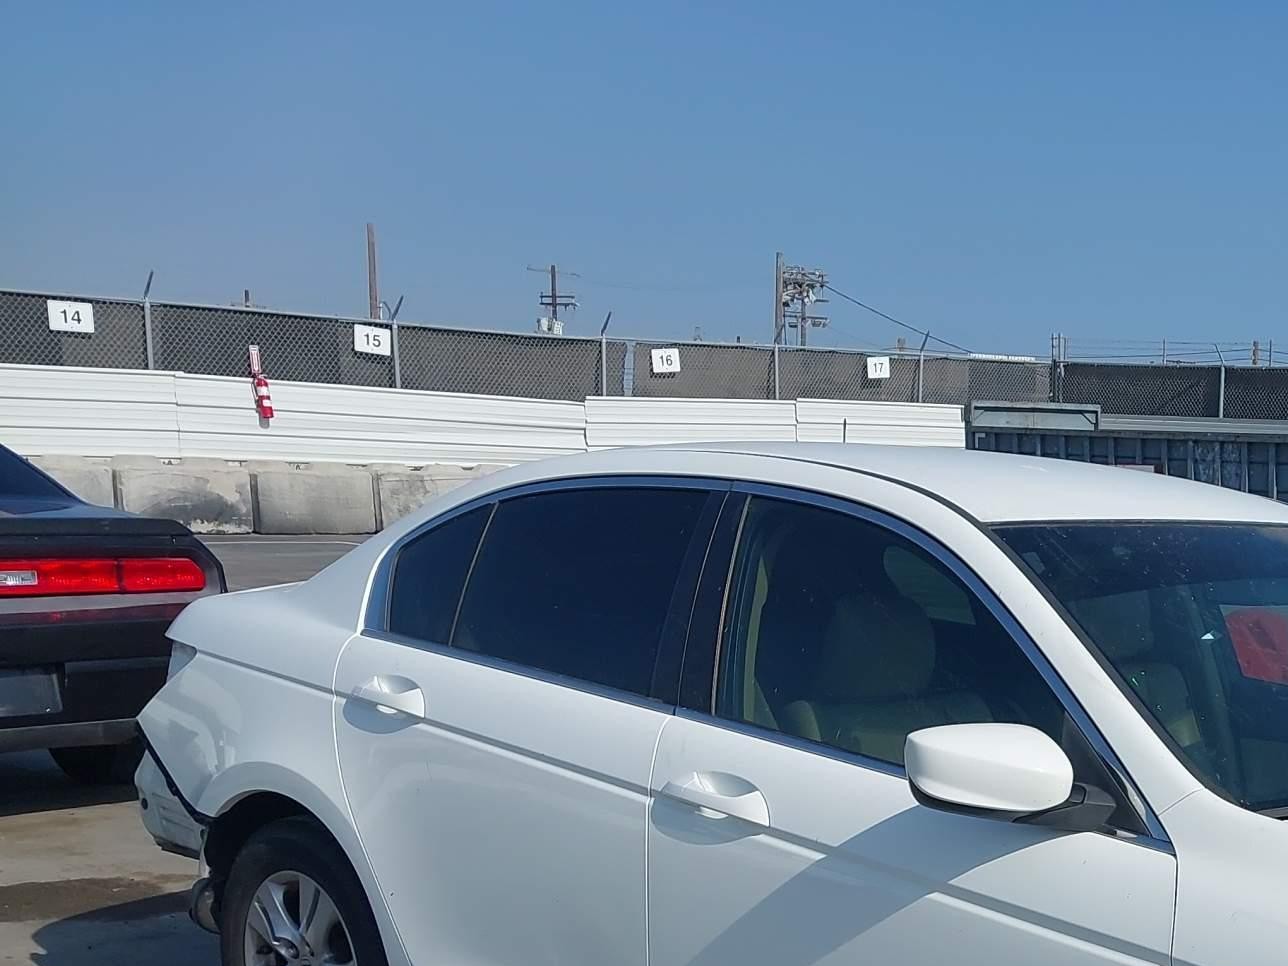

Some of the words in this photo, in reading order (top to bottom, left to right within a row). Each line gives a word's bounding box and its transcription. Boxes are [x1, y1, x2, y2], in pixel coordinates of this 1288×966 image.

[59, 308, 82, 325] 14
[363, 333, 381, 348] 15
[659, 354, 673, 367] 16
[872, 362, 884, 374] 17
